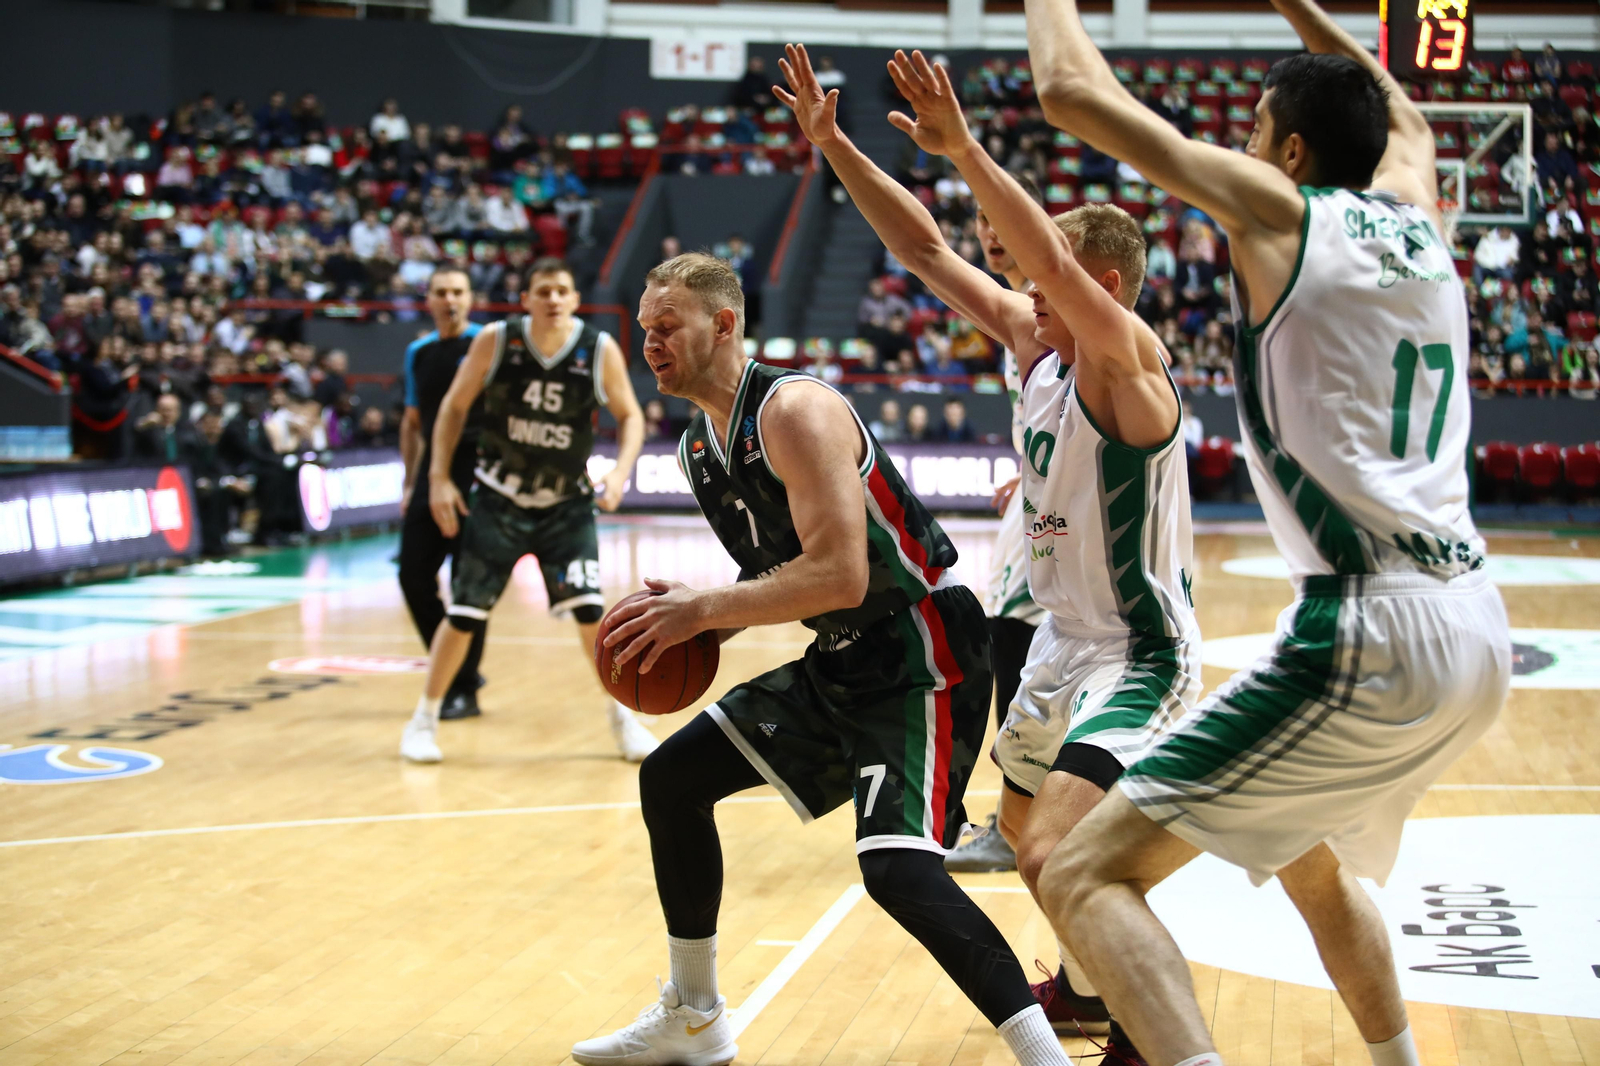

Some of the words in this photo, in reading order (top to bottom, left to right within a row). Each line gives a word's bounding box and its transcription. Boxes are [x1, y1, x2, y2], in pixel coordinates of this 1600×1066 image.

[1415, 19, 1467, 71] 13
[521, 379, 566, 413] 45
[1390, 337, 1455, 464] 17
[506, 414, 574, 450] UNICS
[1023, 426, 1056, 478] 10
[734, 498, 760, 548] 7
[565, 559, 600, 589] 45
[860, 763, 887, 819] 7
